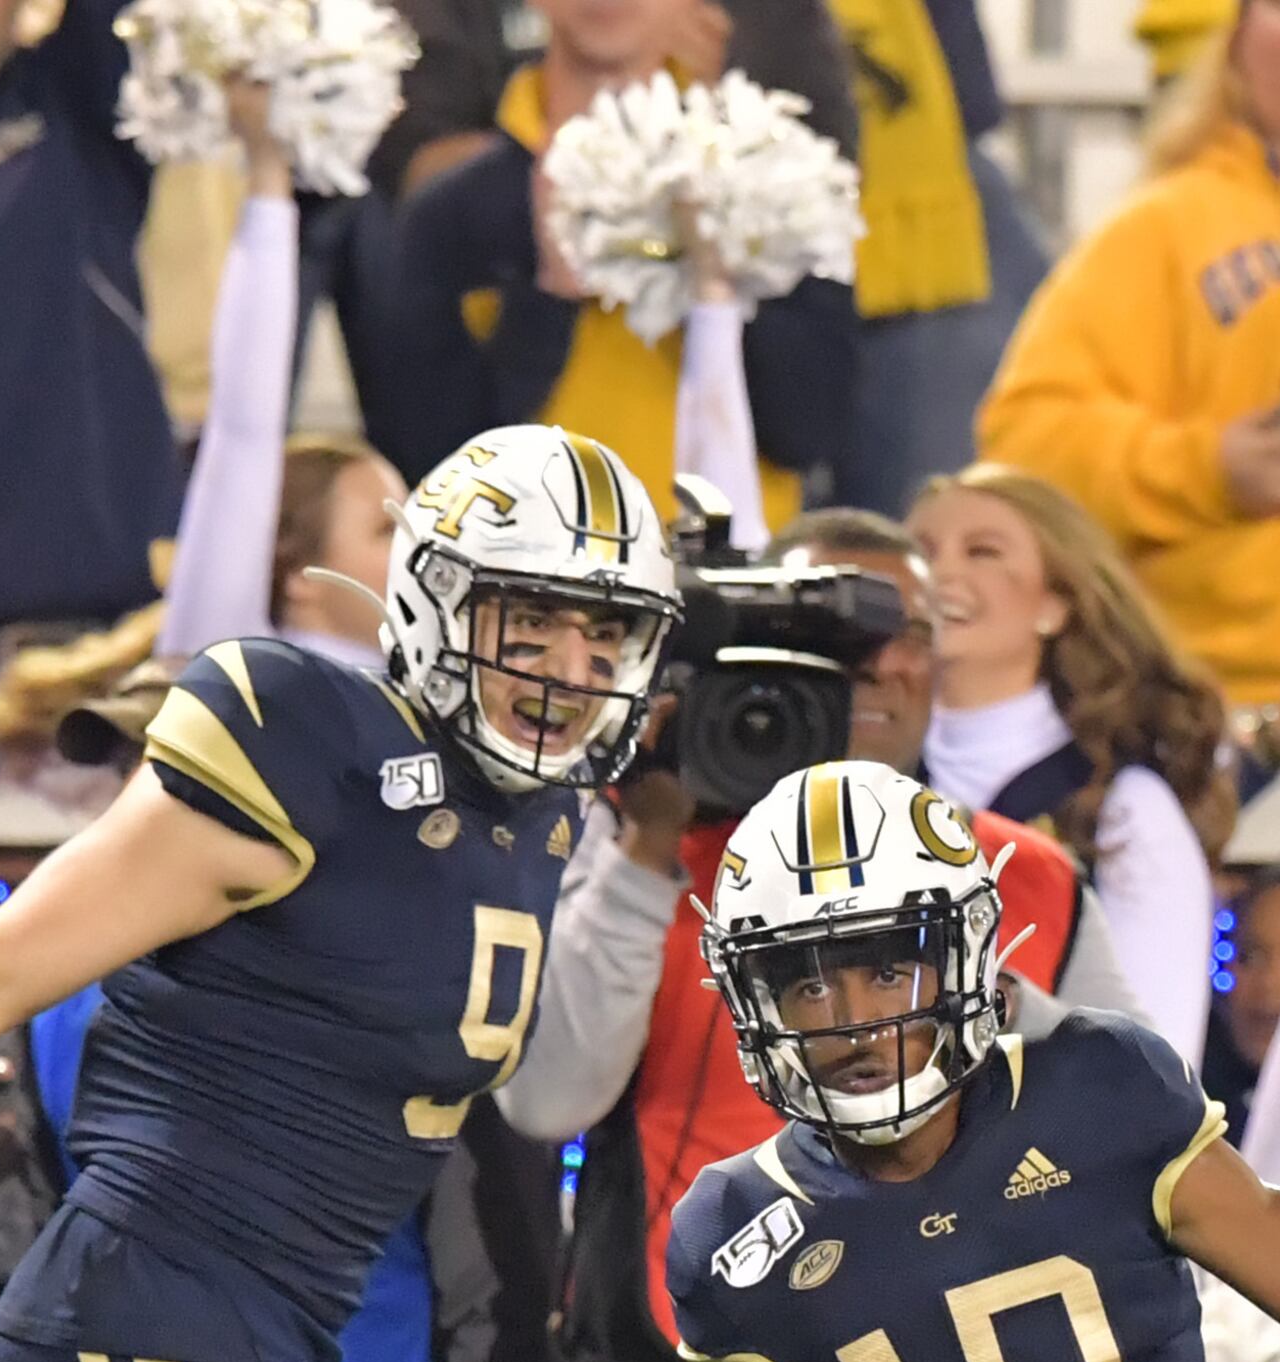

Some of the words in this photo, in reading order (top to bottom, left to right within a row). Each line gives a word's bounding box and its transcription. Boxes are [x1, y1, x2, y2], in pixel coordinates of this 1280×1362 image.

[813, 895, 859, 917] ACC
[402, 905, 544, 1139] 9
[1003, 1169, 1072, 1200] adidas
[712, 1200, 802, 1284] 150
